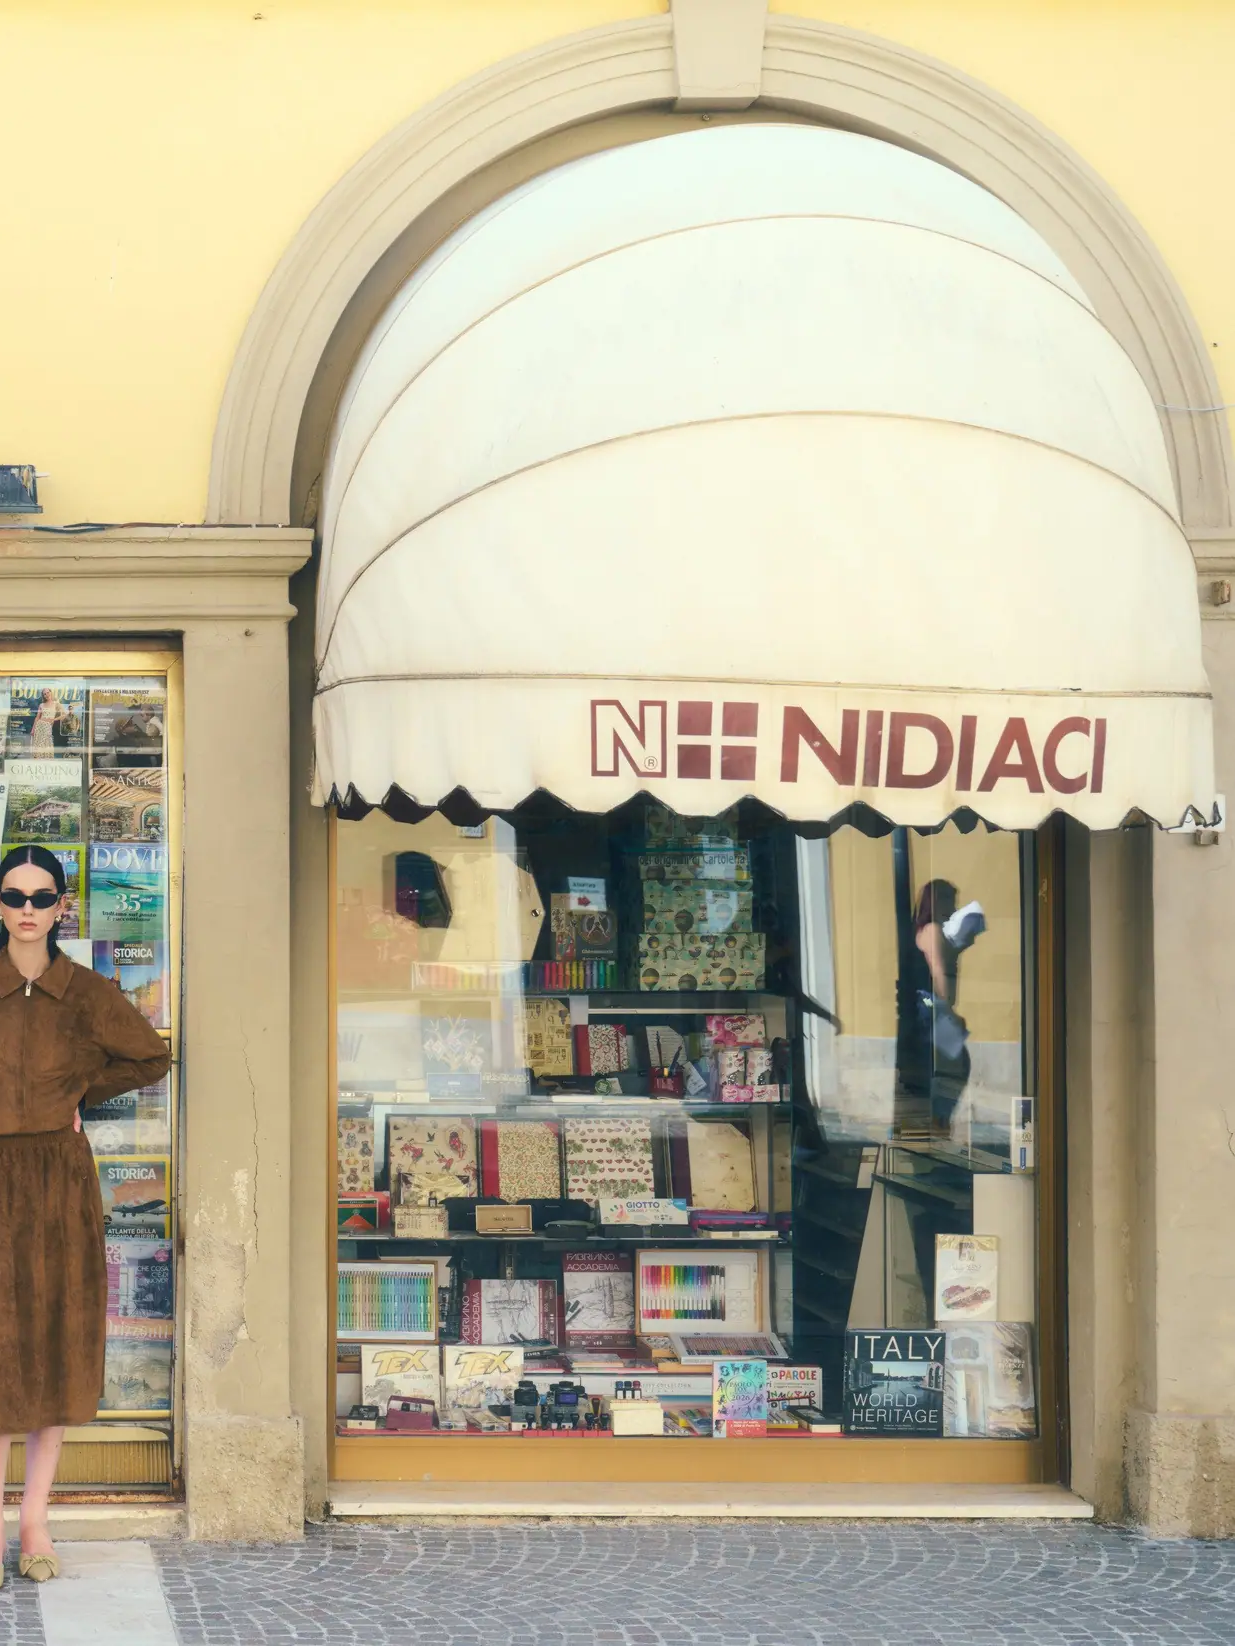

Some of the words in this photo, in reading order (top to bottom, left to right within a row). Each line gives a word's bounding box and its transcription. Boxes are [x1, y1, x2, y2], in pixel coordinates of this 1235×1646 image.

[780, 705, 1107, 794] NIDIACI
[93, 847, 167, 871] DOVE
[116, 893, 140, 911] 35
[113, 948, 153, 958] STORICA
[108, 1168, 156, 1180] STORICA
[626, 1201, 660, 1209] GIOTTO
[106, 1255, 128, 1264] ASA
[461, 1295, 470, 1344] ABRIANO
[472, 1292, 480, 1345] ACCADEMIA
[854, 1335, 942, 1360] ITALY
[372, 1349, 430, 1377] TEX
[455, 1350, 514, 1379] TEX
[779, 1370, 817, 1380] PAROLE
[853, 1393, 917, 1407] WORLD
[852, 1408, 938, 1424] HERITAGE
